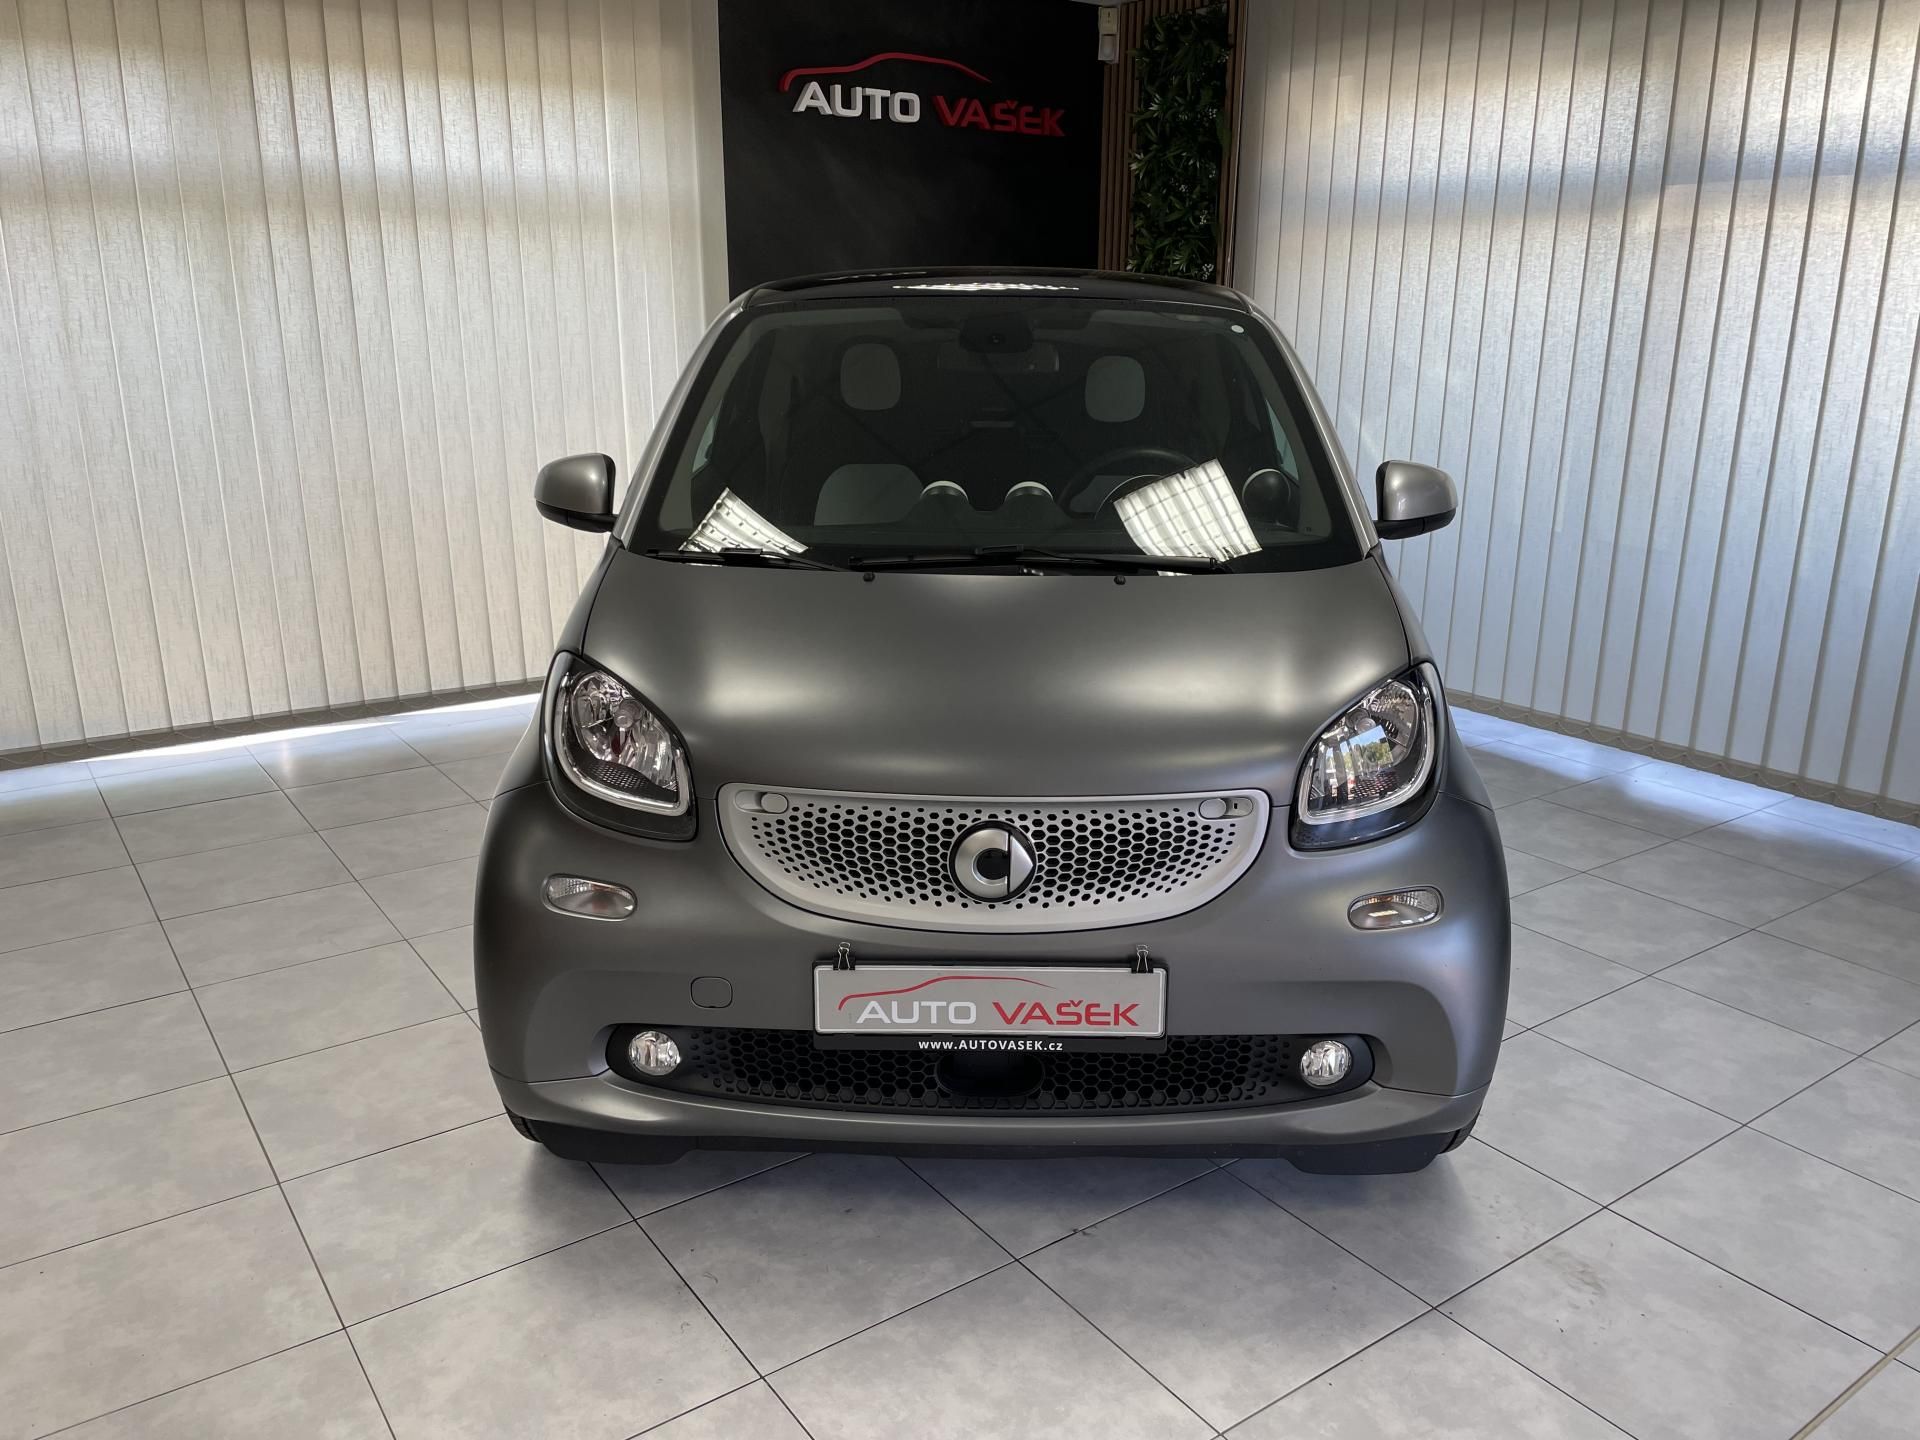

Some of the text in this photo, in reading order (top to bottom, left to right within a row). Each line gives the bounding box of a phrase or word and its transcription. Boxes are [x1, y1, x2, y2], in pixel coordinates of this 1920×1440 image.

[793, 81, 1066, 137] AUTO VAŠEK
[856, 1000, 1140, 1027] AUTO VAŠEK
[918, 1040, 1064, 1052] www.AUTOVASEK.cz
